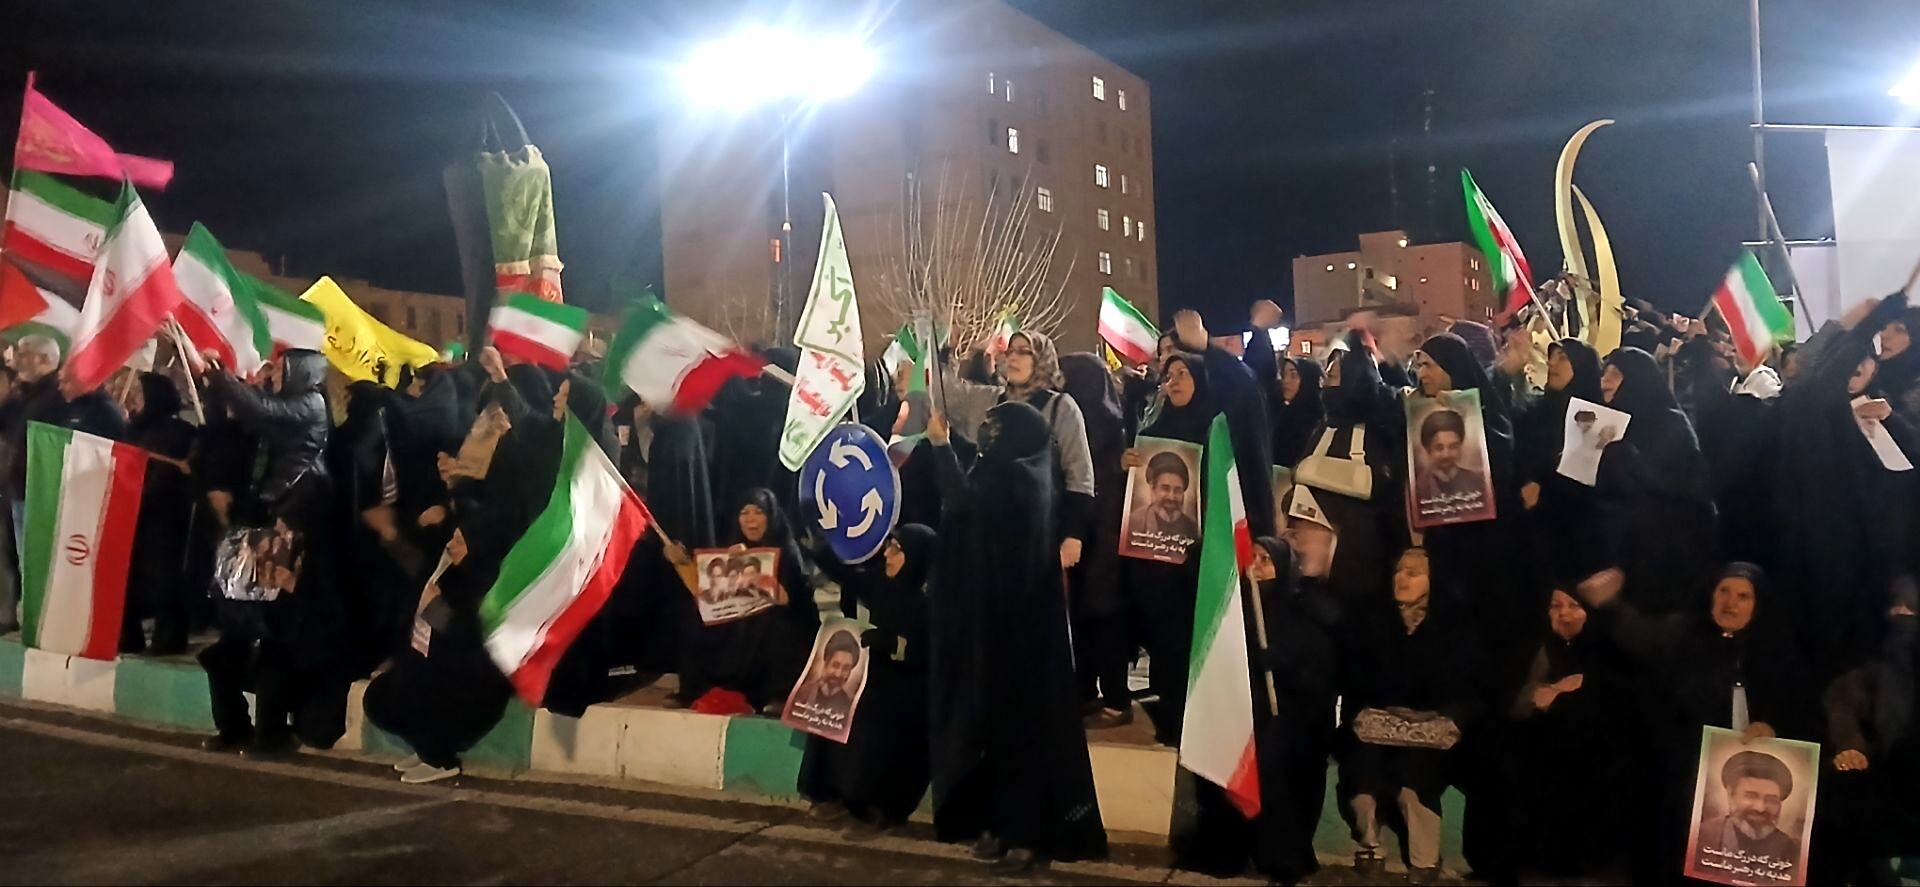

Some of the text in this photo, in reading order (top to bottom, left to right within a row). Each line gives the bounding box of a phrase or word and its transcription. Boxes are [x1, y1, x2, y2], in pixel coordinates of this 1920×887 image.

[1701, 858, 1792, 881] هدیه به رهبر ماست
[1703, 846, 1793, 870] خونی که در رگ ماست
